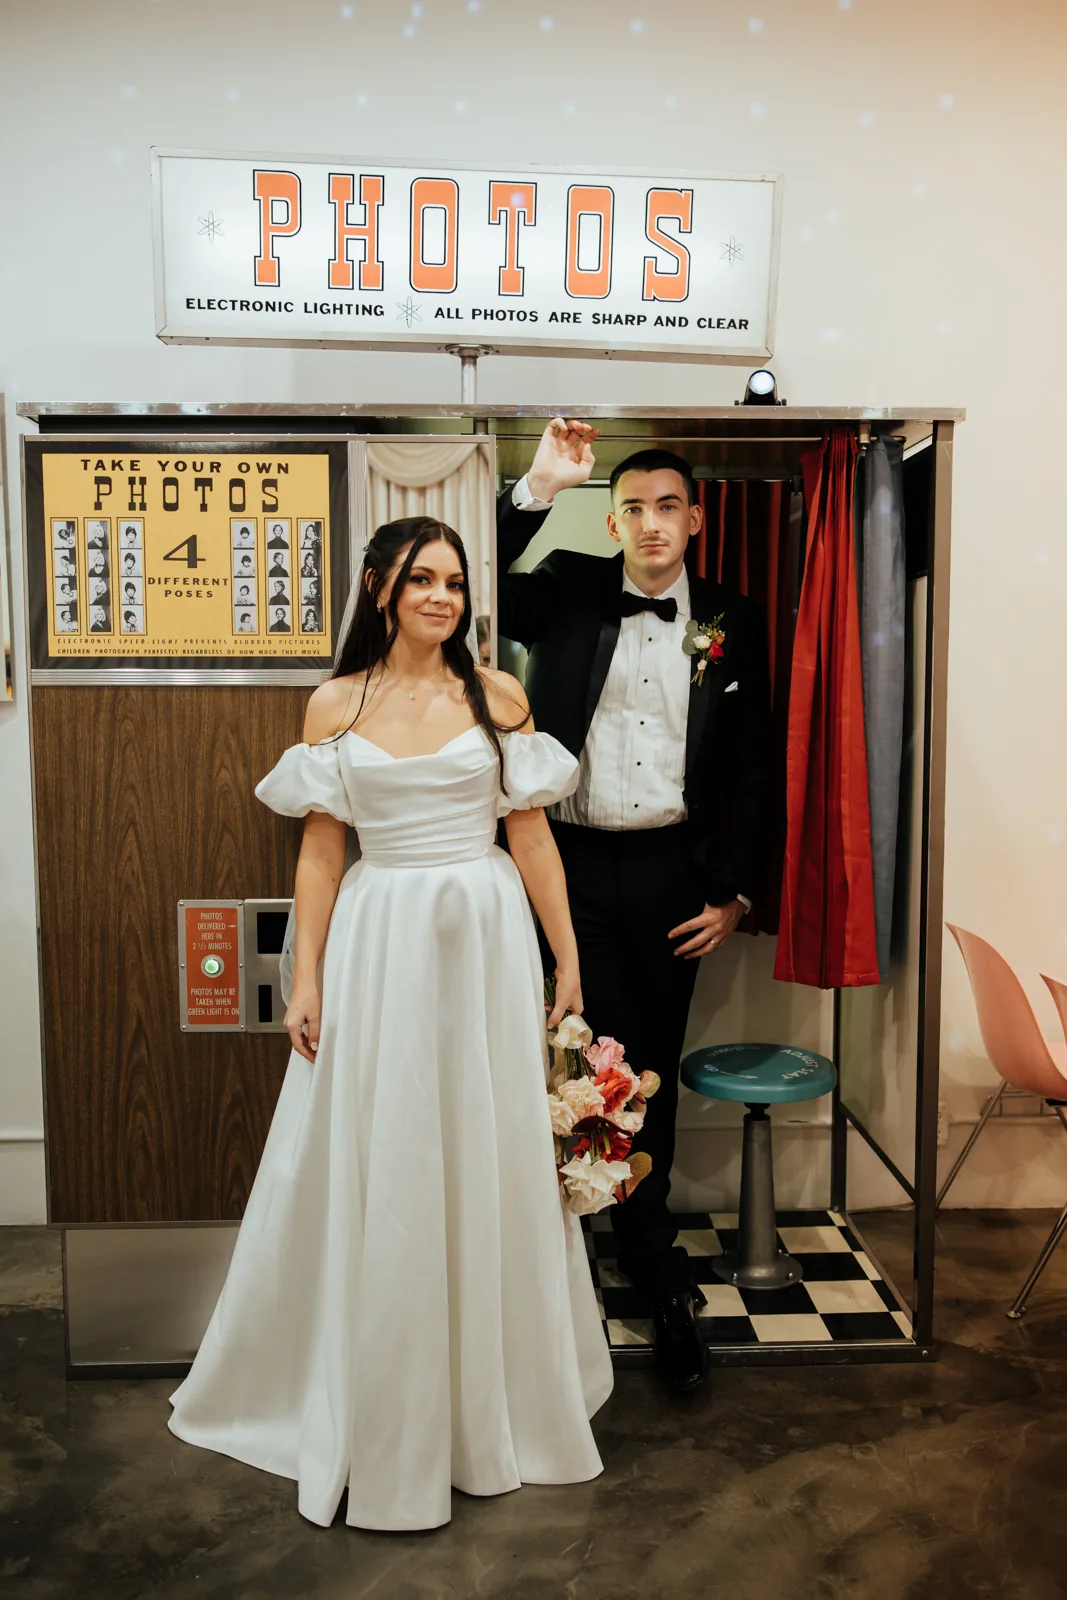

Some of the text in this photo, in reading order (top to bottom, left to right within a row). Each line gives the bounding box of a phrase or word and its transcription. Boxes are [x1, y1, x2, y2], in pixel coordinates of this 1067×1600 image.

[253, 169, 694, 303] PHOTOS
[186, 298, 385, 317] ELECTRONIC LIGHTING
[434, 307, 749, 331] ALL PHOTOS ARE SHARP AND CLEAR
[81, 459, 290, 475] TAKE YOUR OWN
[93, 476, 279, 513] PHOTOS
[162, 534, 206, 569] 4
[148, 577, 229, 587] DIFFERENT
[164, 589, 213, 598] POSES
[200, 912, 223, 920] PHOTOS
[197, 922, 226, 930] DELIVERED
[201, 932, 223, 940] HERE IN
[192, 942, 197, 950] 2
[207, 942, 232, 950] MINUTES
[190, 988, 236, 996] PHOTOS MAY BE
[195, 998, 231, 1006] TAKEN WHEN
[188, 1008, 239, 1016] GREEN LIGHT IS ON
[779, 1049, 819, 1080] ADJUST SEAT
